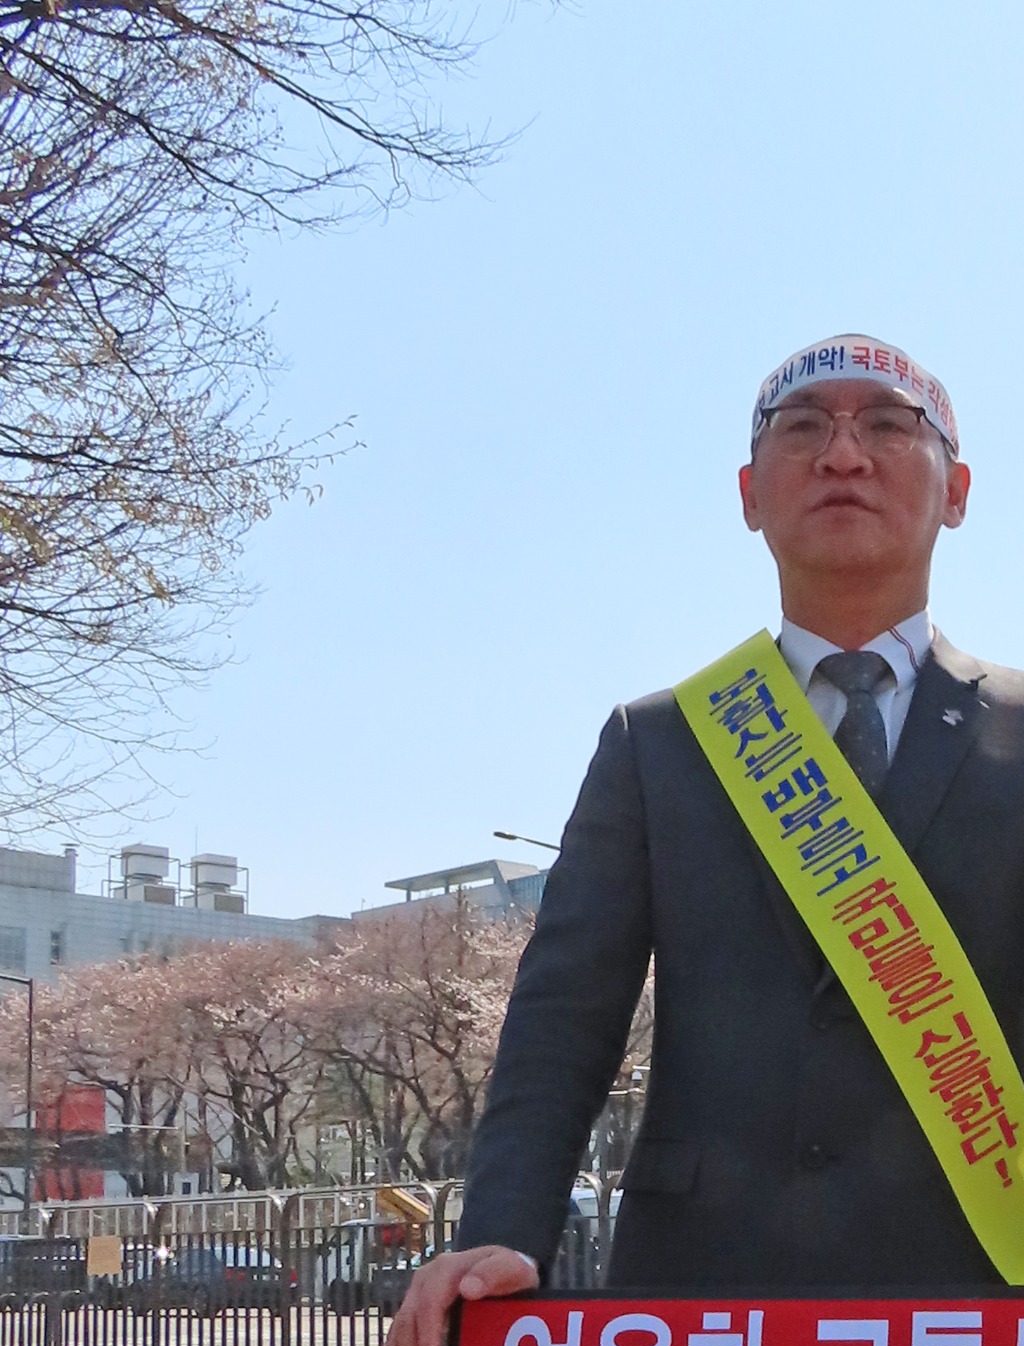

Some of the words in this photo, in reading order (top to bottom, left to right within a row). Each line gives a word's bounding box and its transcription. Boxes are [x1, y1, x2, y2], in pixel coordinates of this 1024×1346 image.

[799, 345, 845, 377] 개악!
[851, 346, 924, 396] 국토부는
[709, 668, 802, 782] 보험사는
[761, 758, 880, 896] 배부르고
[833, 877, 954, 1024] 국민들은
[914, 1011, 1019, 1189] 신음한다!
